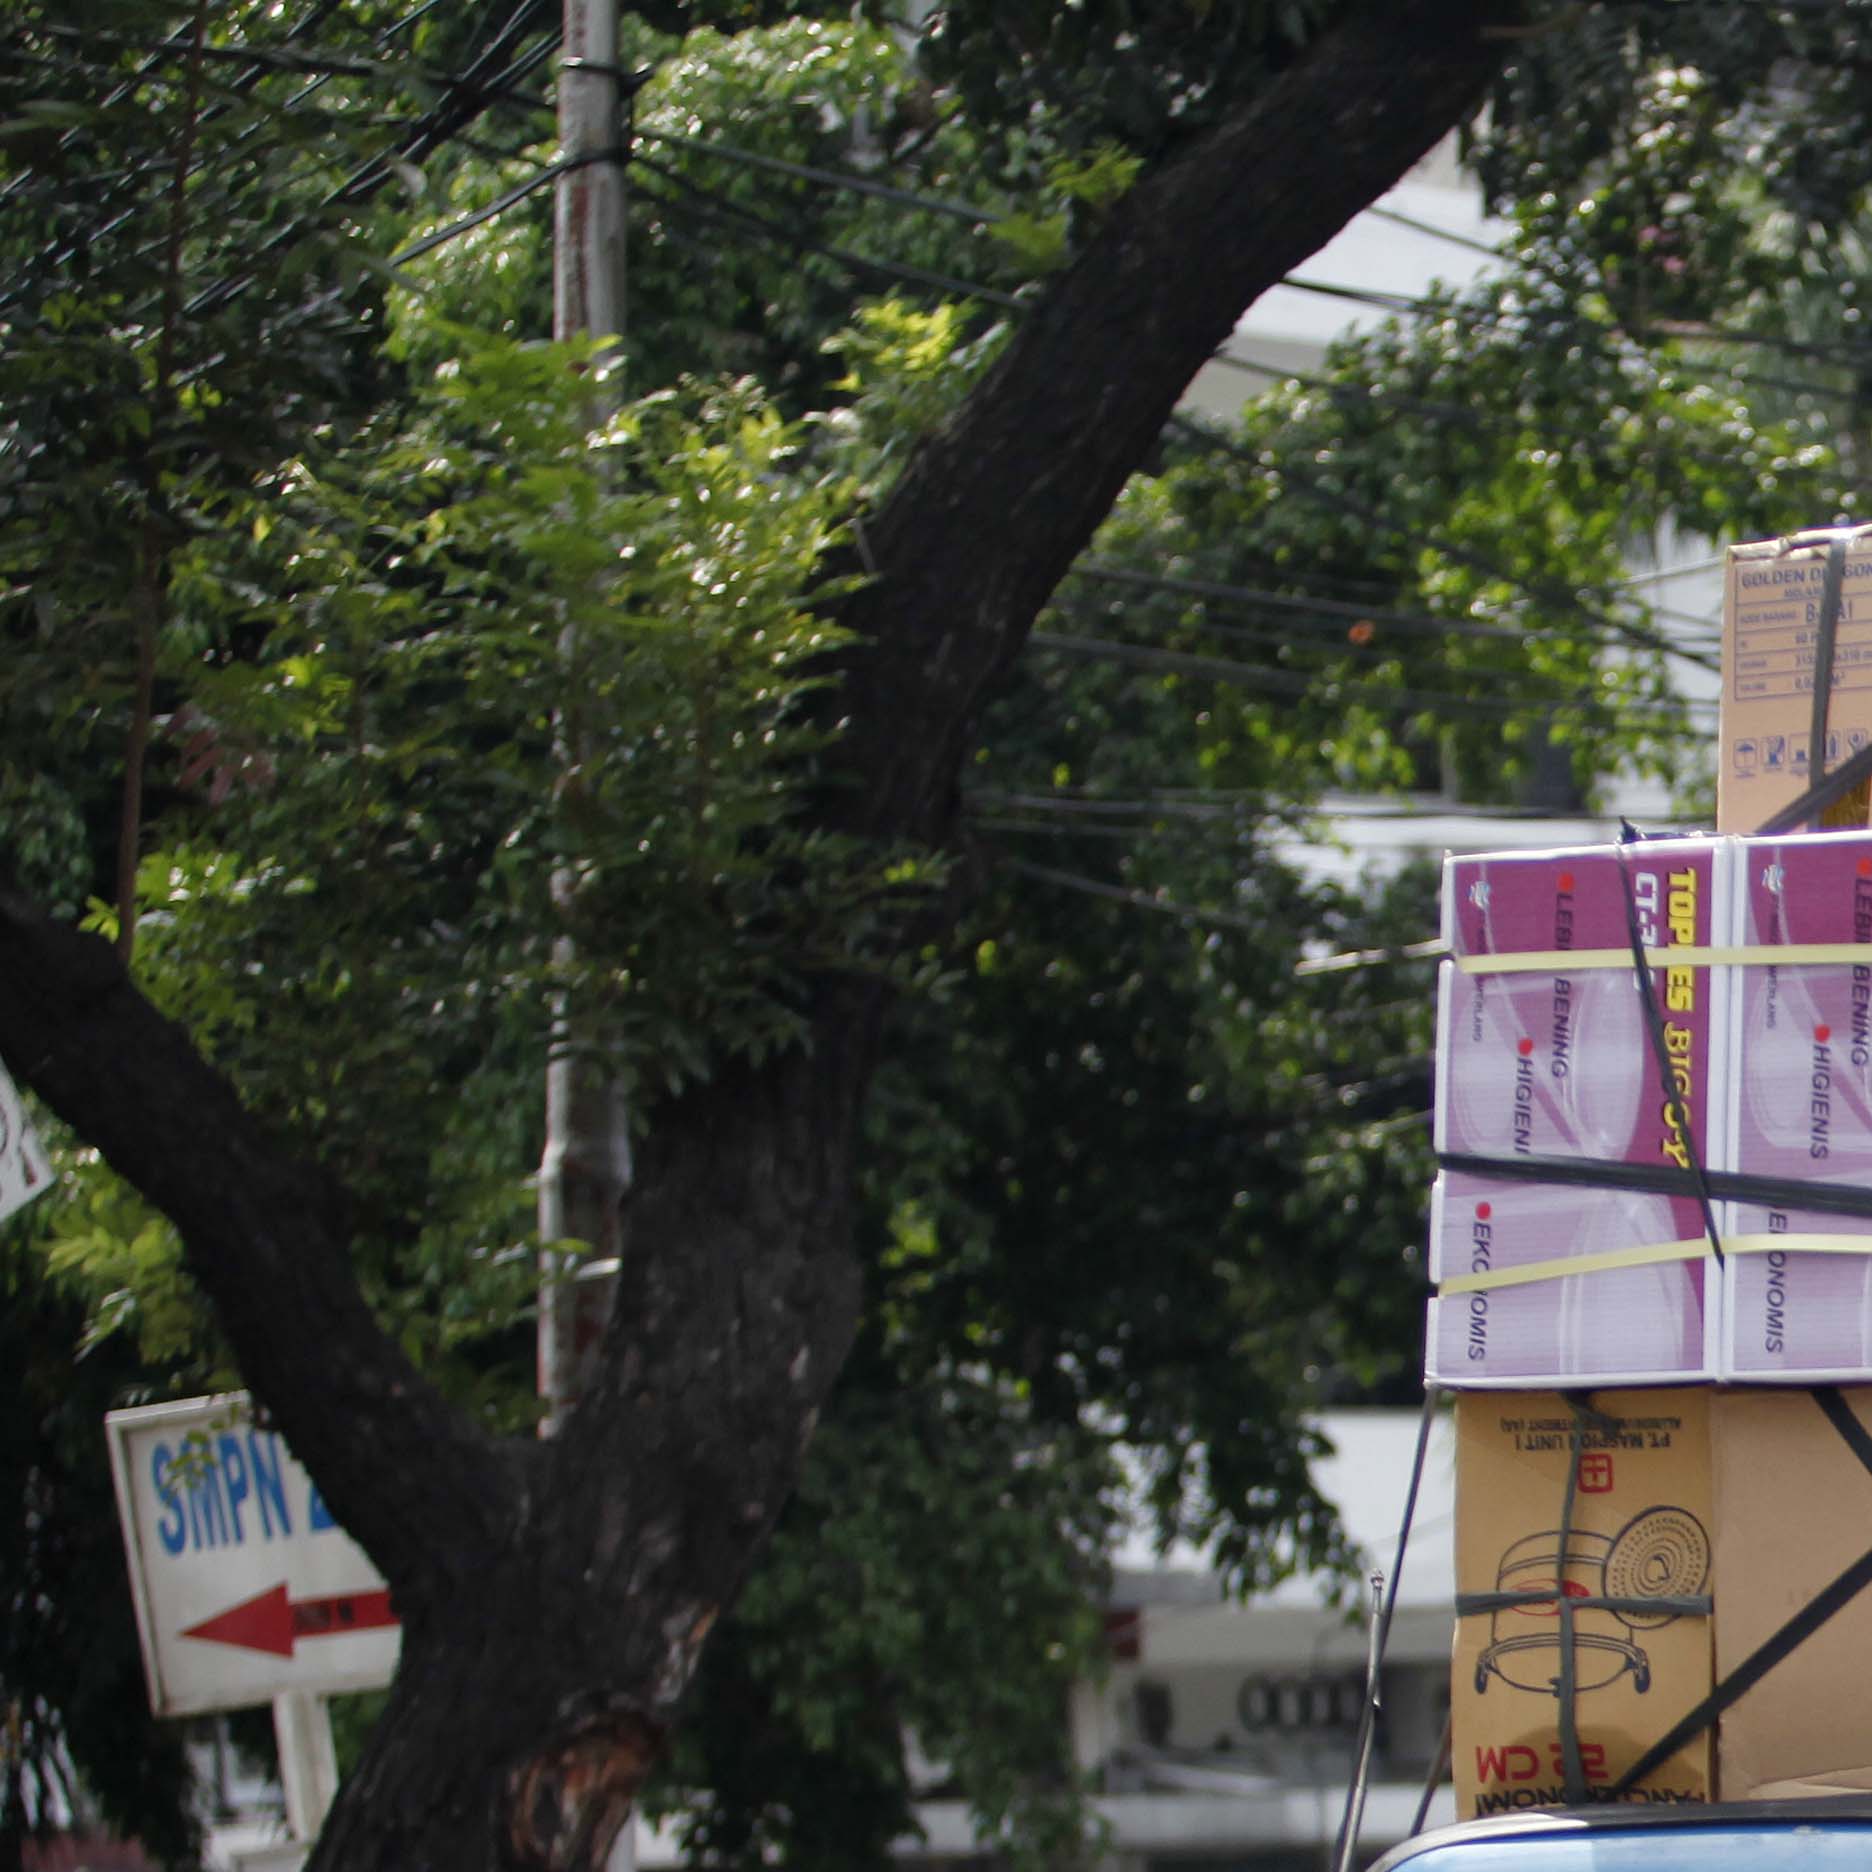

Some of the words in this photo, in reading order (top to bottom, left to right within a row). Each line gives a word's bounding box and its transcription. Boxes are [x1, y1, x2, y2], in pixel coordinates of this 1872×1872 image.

[1742, 565, 1805, 589] GOLDEN
[1665, 867, 1698, 1013] TOPES
[1550, 977, 1572, 1080] BENING
[1849, 964, 1872, 1068] BENING
[1512, 1056, 1535, 1154] HIGIENI
[1809, 1043, 1832, 1161] HIGIENIS
[1467, 1221, 1492, 1361] EKOOMIS
[1525, 1434, 1563, 1451] UNIT
[1647, 1432, 1671, 1448] PT.
[152, 1430, 293, 1558] SMPN
[1475, 1744, 1541, 1784] CM
